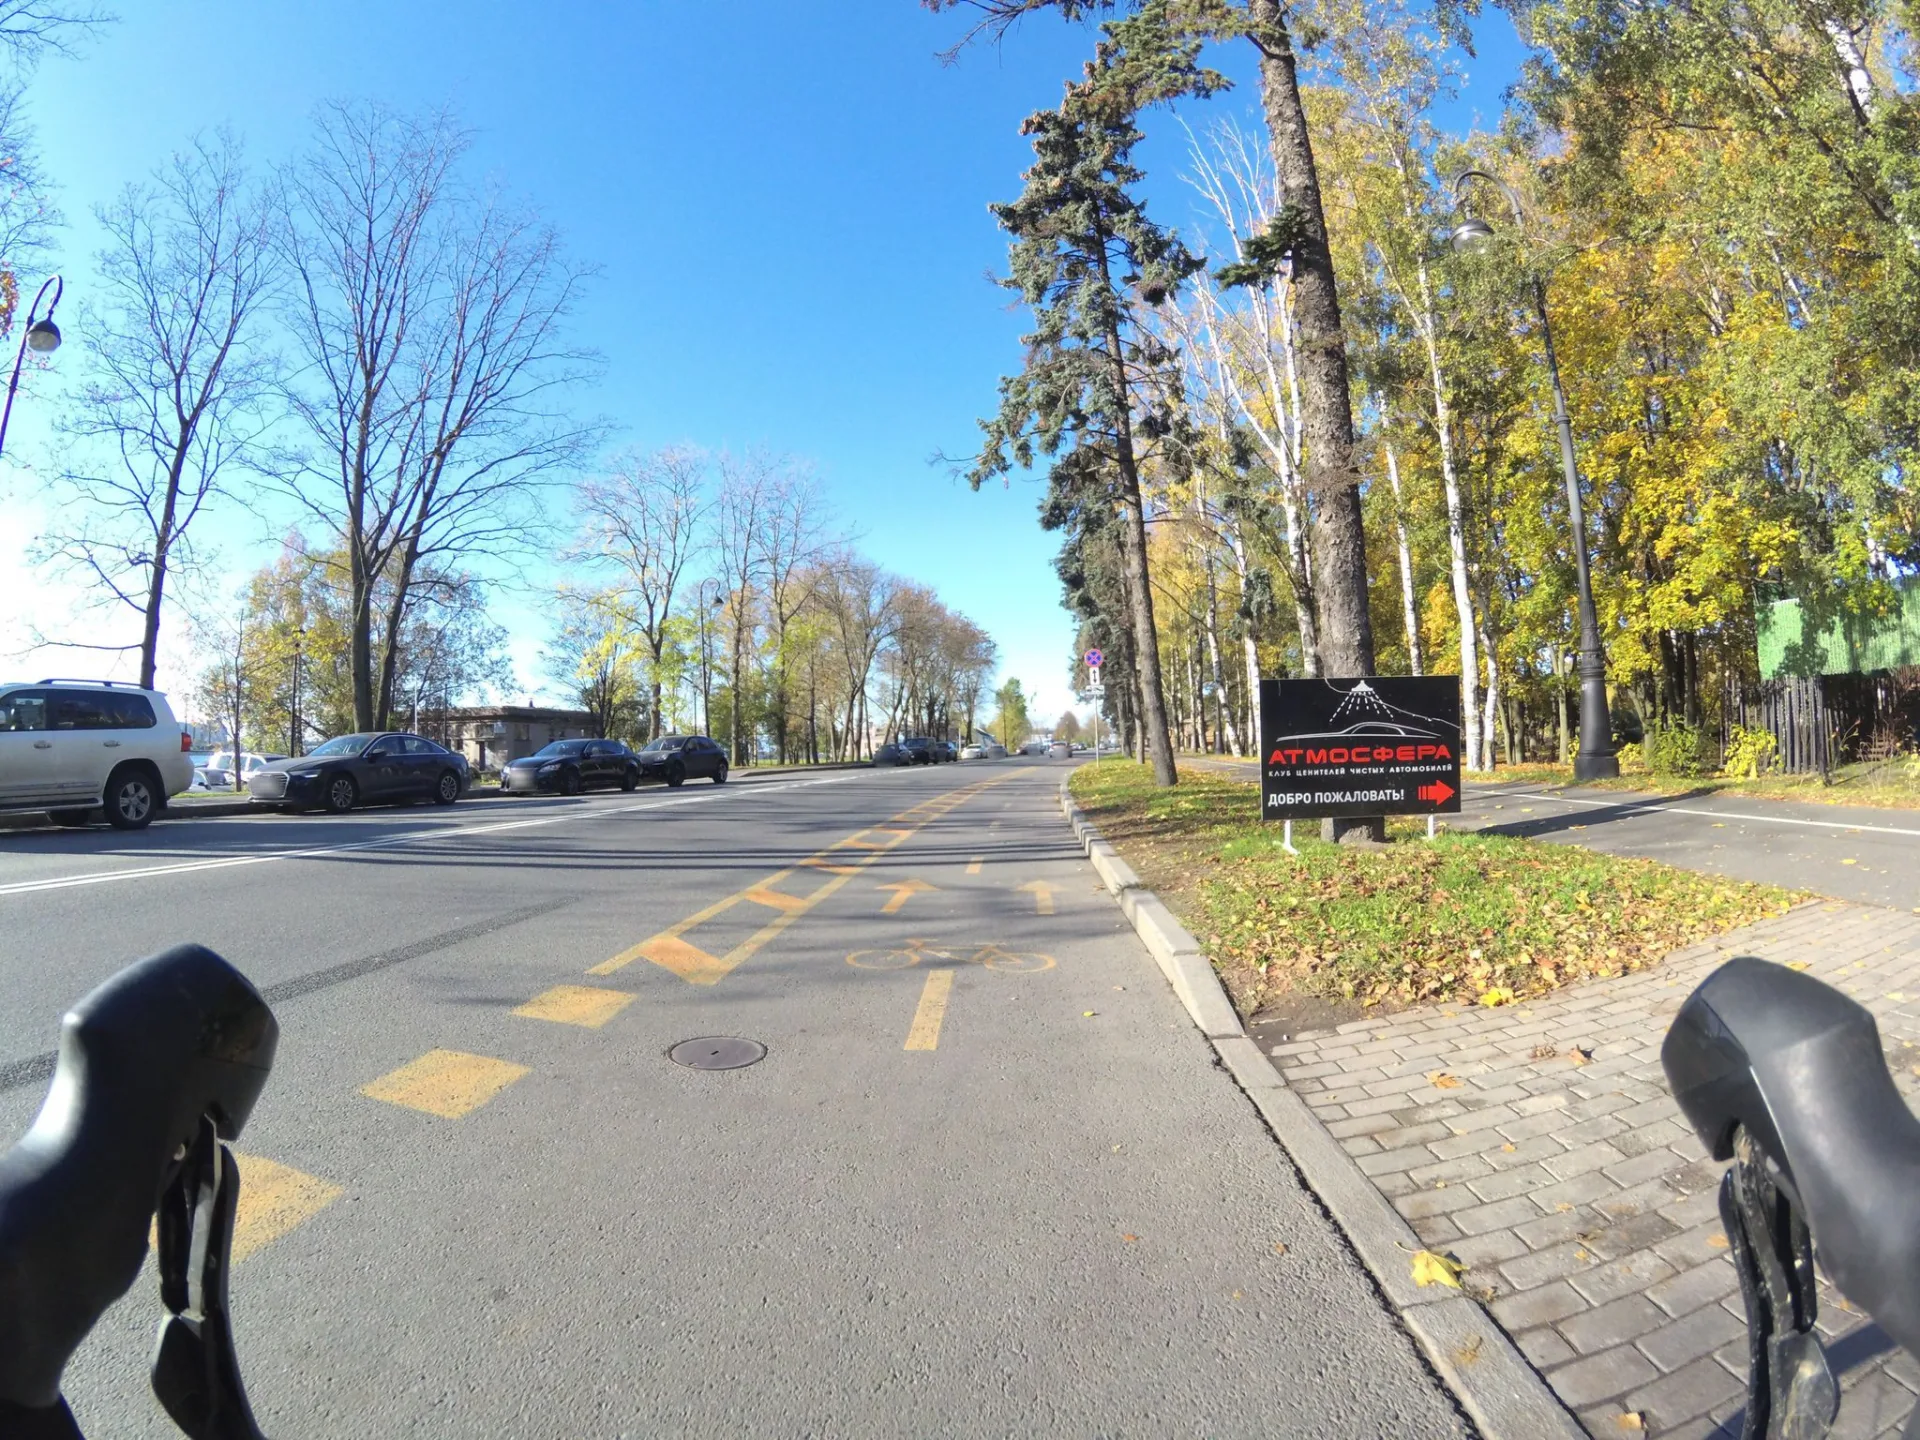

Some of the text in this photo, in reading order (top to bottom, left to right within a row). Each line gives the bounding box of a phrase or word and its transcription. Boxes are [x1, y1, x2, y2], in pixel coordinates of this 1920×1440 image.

[1268, 745, 1451, 765] АТМОСФЕРА
[1296, 767, 1346, 777] ЦЕНИТЕЛЕЙ
[1350, 767, 1385, 775] ЧИСТЫХ
[1389, 763, 1453, 773] АВТОМОБИЛЕЙ
[1268, 789, 1405, 807] ДОБРО ПОЖАЛОВАТЬ!
